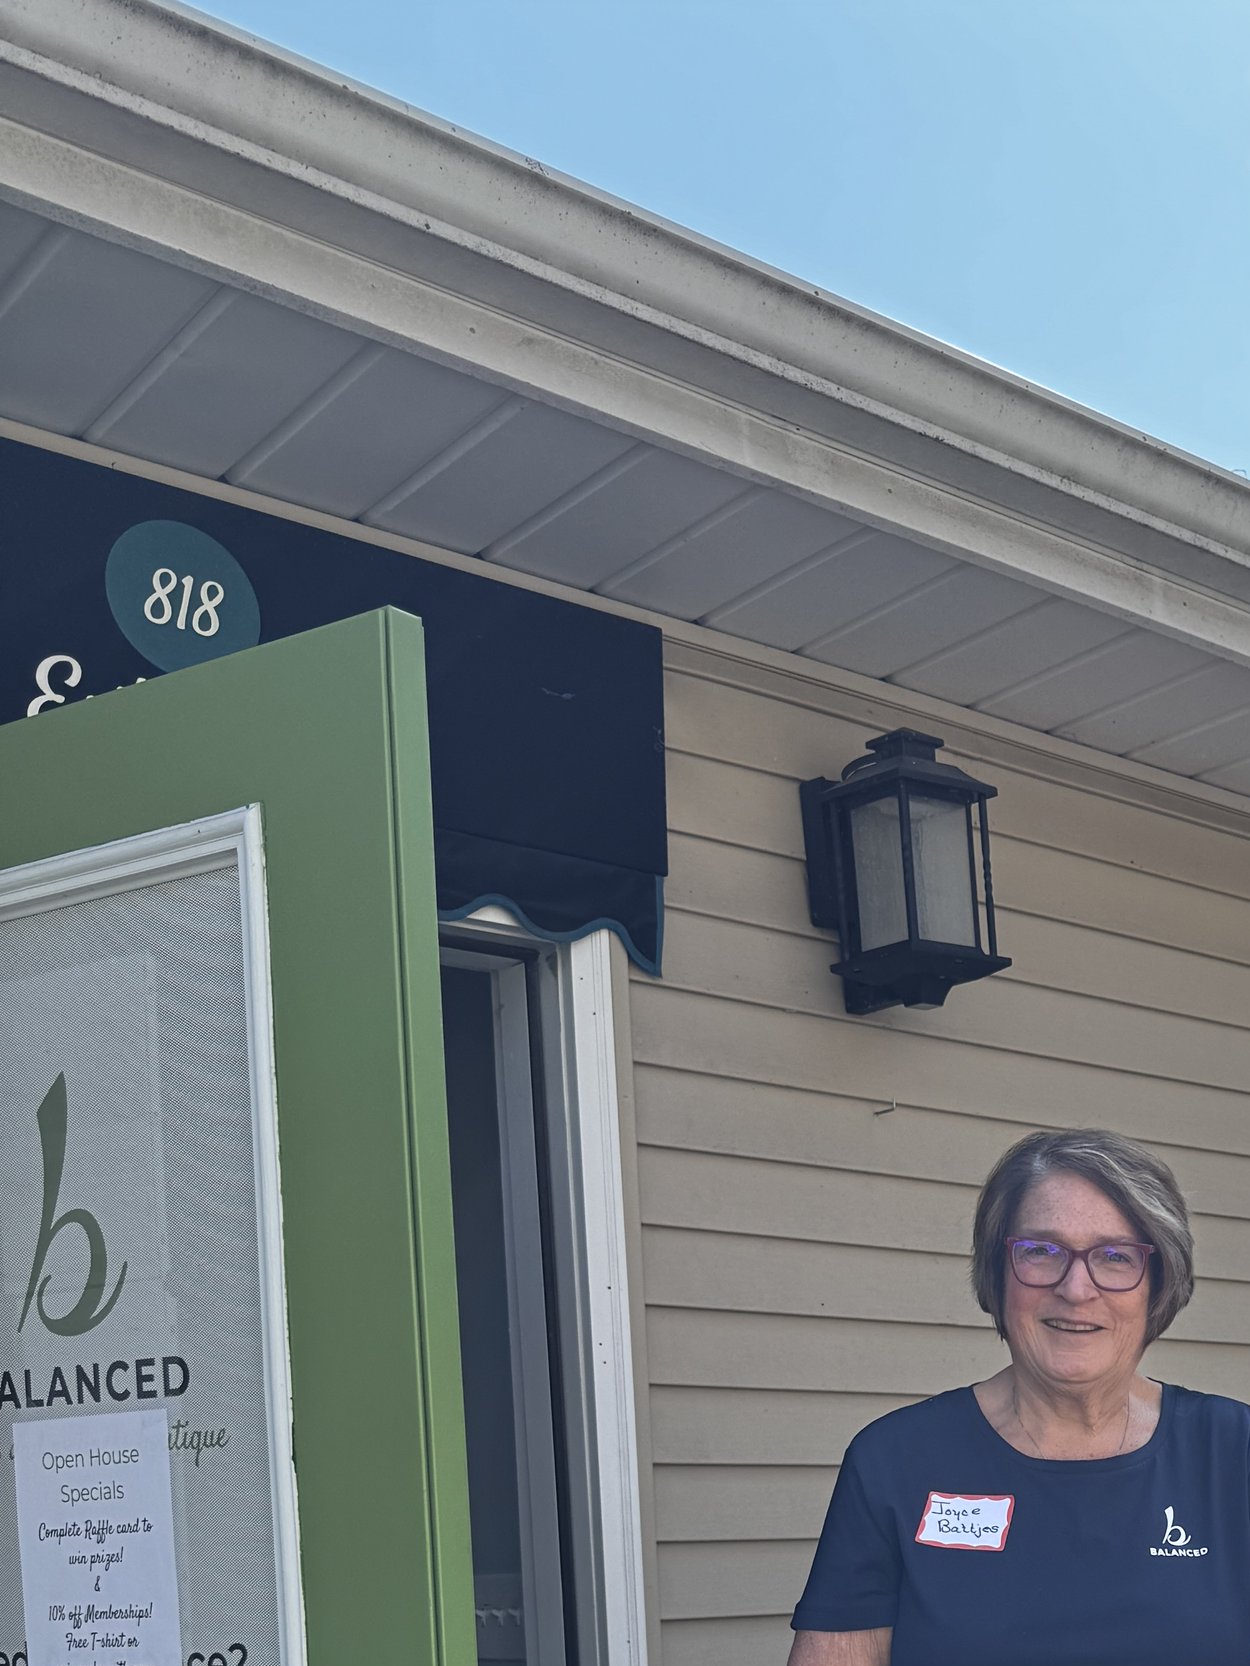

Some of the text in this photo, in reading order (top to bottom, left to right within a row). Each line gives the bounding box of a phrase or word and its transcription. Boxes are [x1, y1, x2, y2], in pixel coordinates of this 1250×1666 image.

[144, 568, 224, 637] 818
[0, 1355, 190, 1409] ALANCED
[42, 1448, 139, 1474] Open House
[61, 1480, 125, 1507] Specials
[931, 1501, 981, 1521] Joyce
[38, 1517, 154, 1545] Complete Raffle card to
[69, 1546, 124, 1572] win prizes!
[1149, 1547, 1208, 1557] BALANCED
[94, 1575, 101, 1592] &
[48, 1602, 153, 1629] 10% off Memberships!
[65, 1632, 140, 1651] Free T-shirt or
